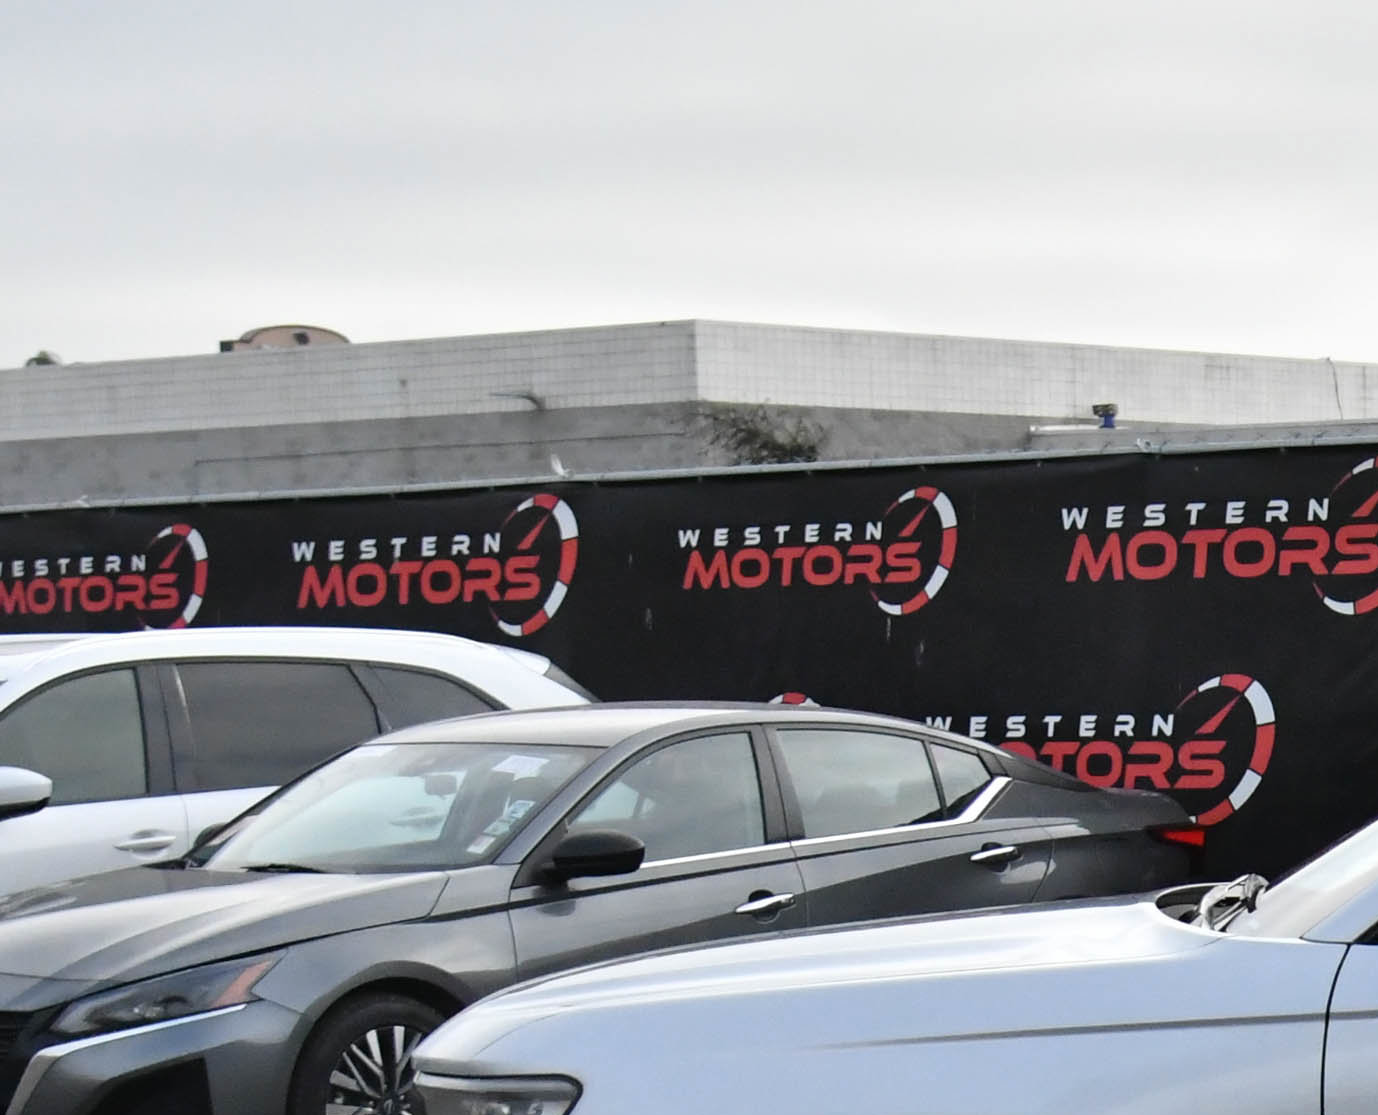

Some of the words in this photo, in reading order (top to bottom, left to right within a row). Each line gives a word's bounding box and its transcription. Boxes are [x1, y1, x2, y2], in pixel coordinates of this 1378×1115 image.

[1061, 497, 1330, 531] WESTERN
[292, 532, 501, 562] WESTERN
[678, 521, 882, 548] WESTERN
[0, 554, 146, 577] ESTERN
[297, 555, 541, 609] MOTORS
[682, 541, 922, 590] MOTORS
[0, 573, 180, 615] MOTORS
